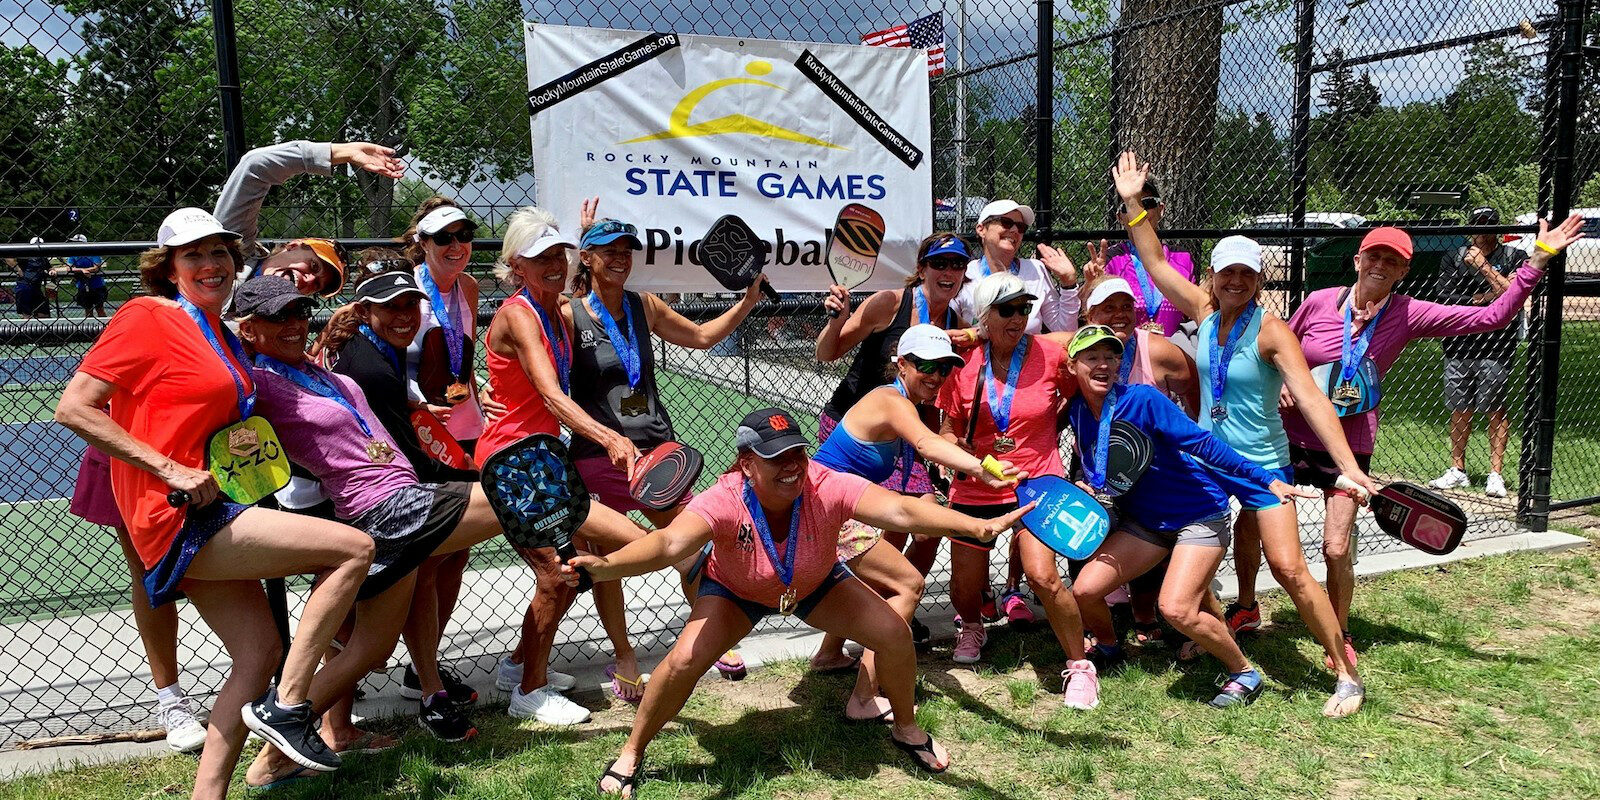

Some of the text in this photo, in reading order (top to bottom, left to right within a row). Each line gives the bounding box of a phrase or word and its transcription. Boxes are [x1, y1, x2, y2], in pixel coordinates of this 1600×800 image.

[529, 34, 676, 108] RockyMountainStateGames.org
[804, 55, 918, 162] RockyMountainStateGames.org
[586, 152, 818, 169] ROCKY MOUNTAIN
[625, 167, 887, 200] STATE GAMES
[533, 507, 570, 531] OUTBREAK
[1041, 493, 1070, 530] TANTRUM
